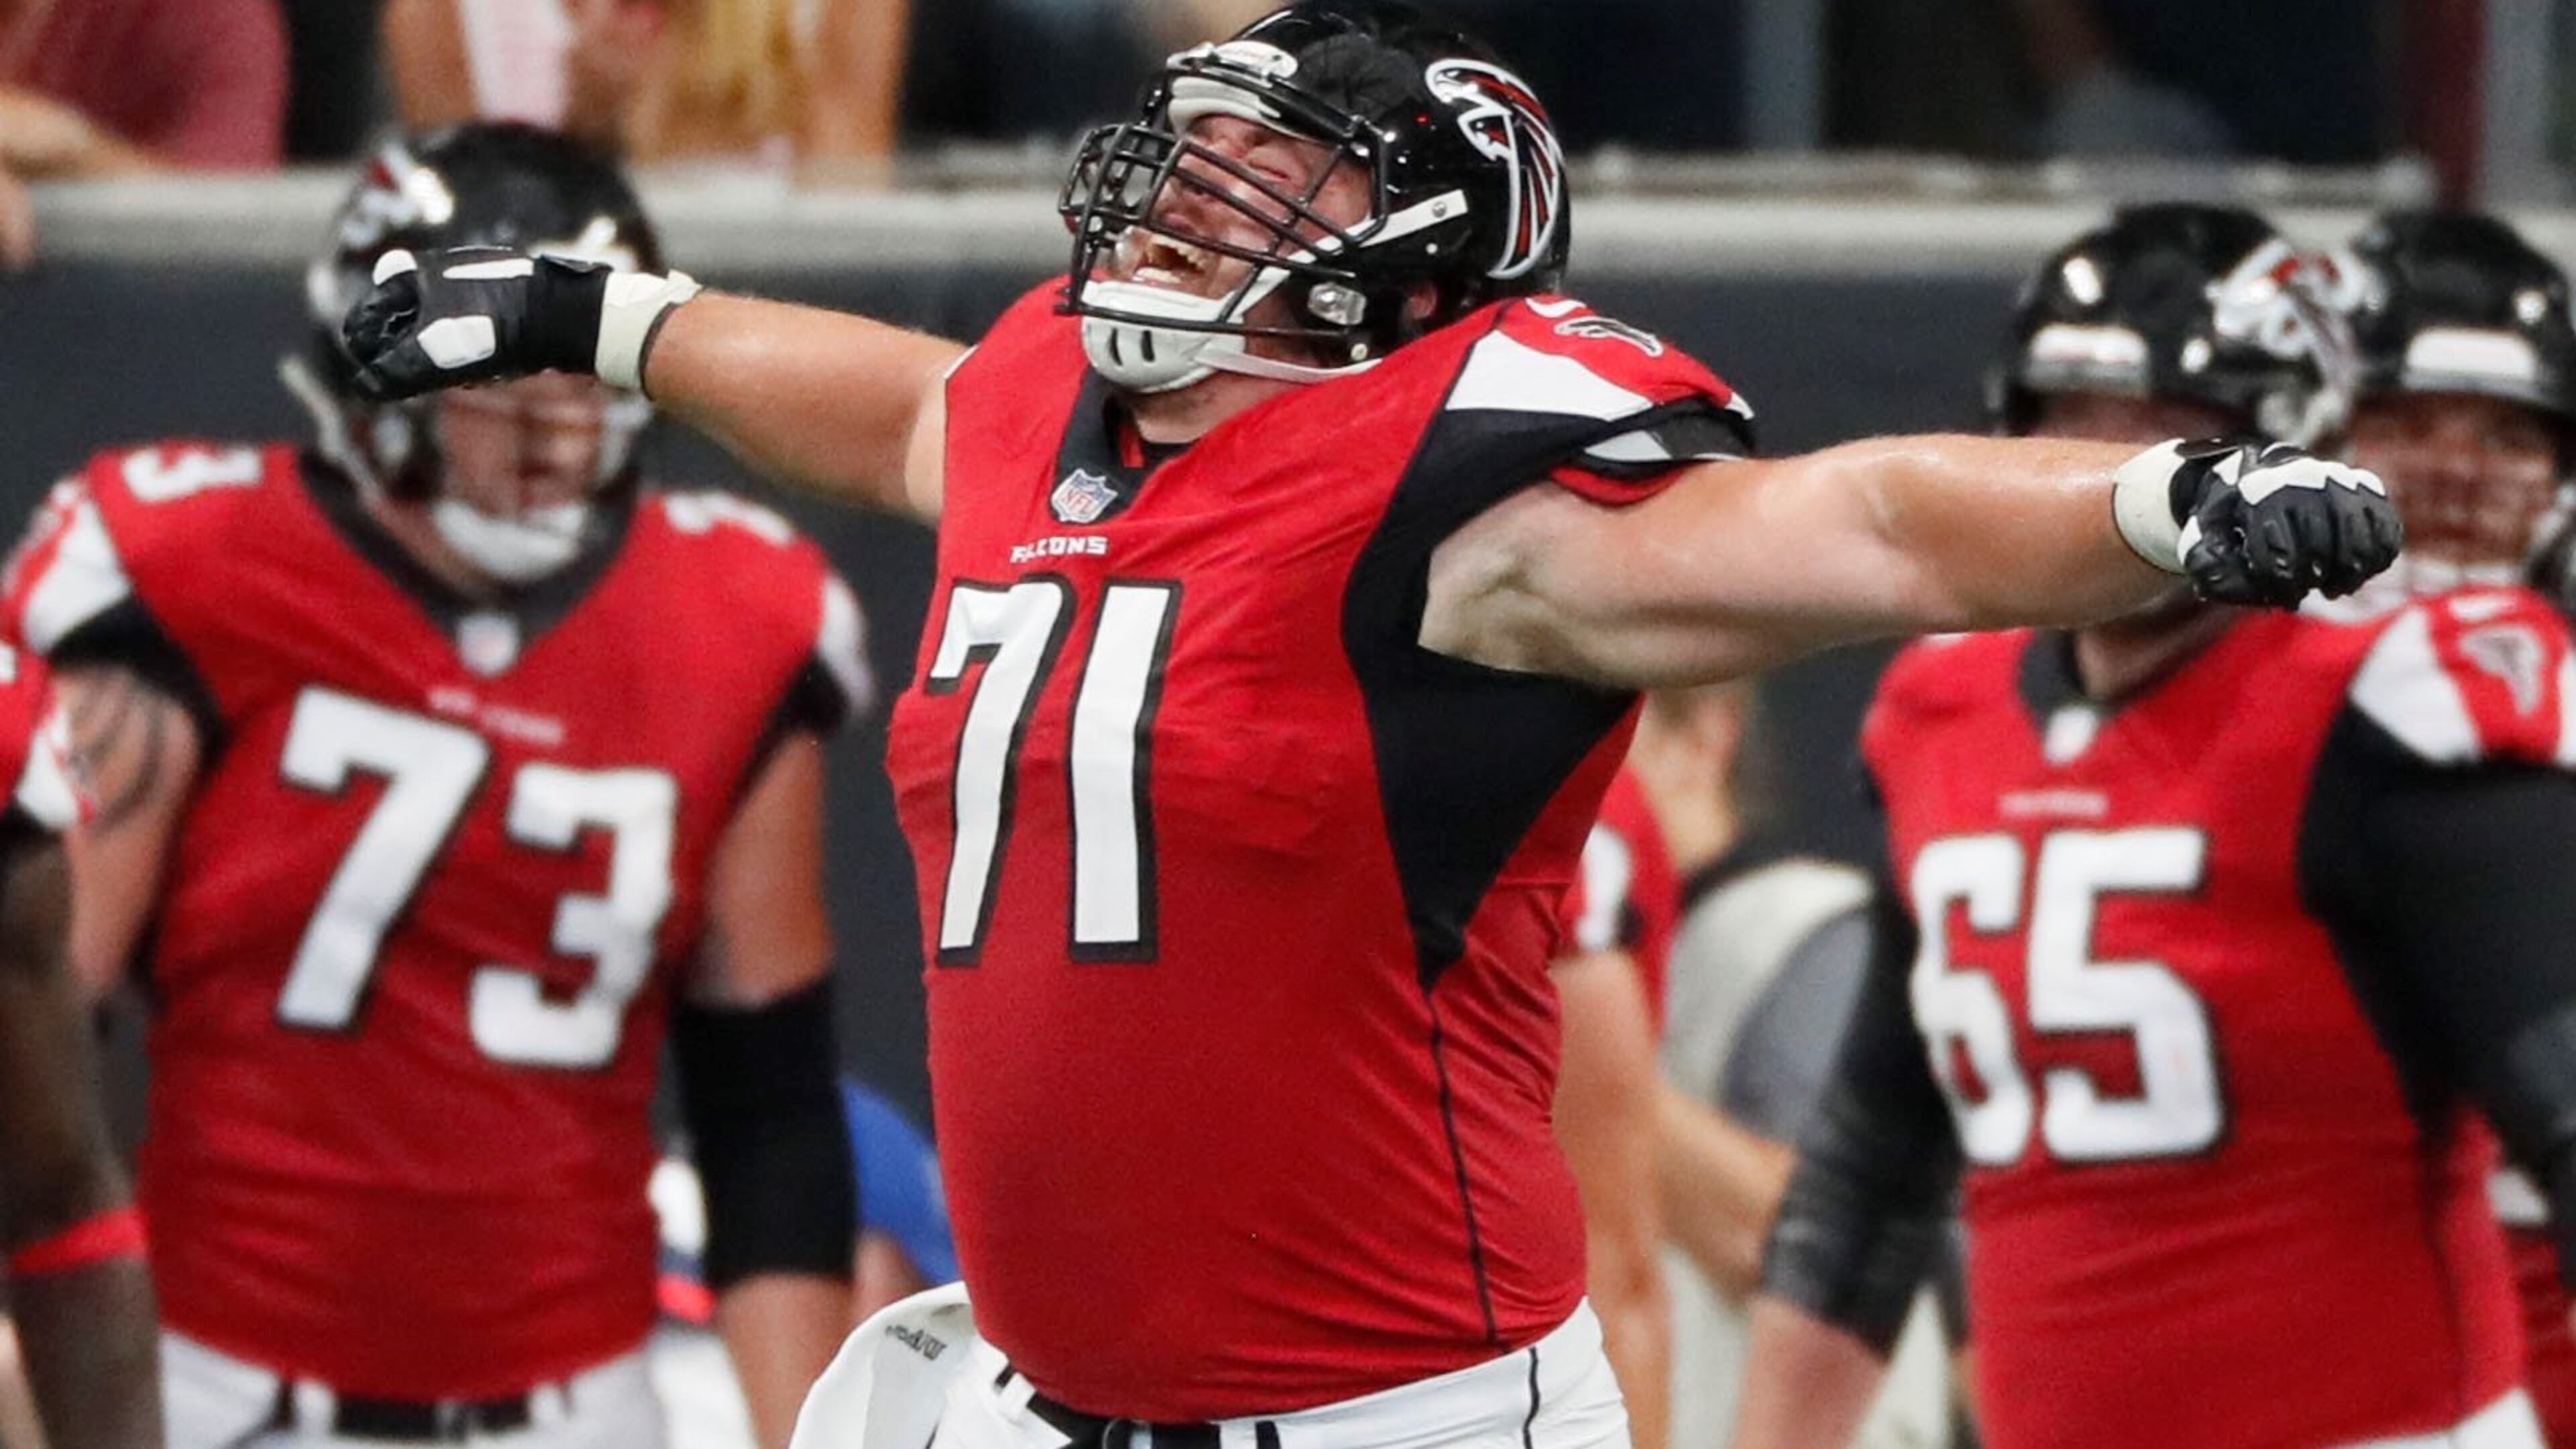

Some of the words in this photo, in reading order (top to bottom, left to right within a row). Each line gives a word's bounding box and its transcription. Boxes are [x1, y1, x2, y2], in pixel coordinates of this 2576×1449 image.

[276, 682, 678, 1068] 73
[927, 574, 1181, 965] 71
[1909, 825, 2222, 1165] 65
